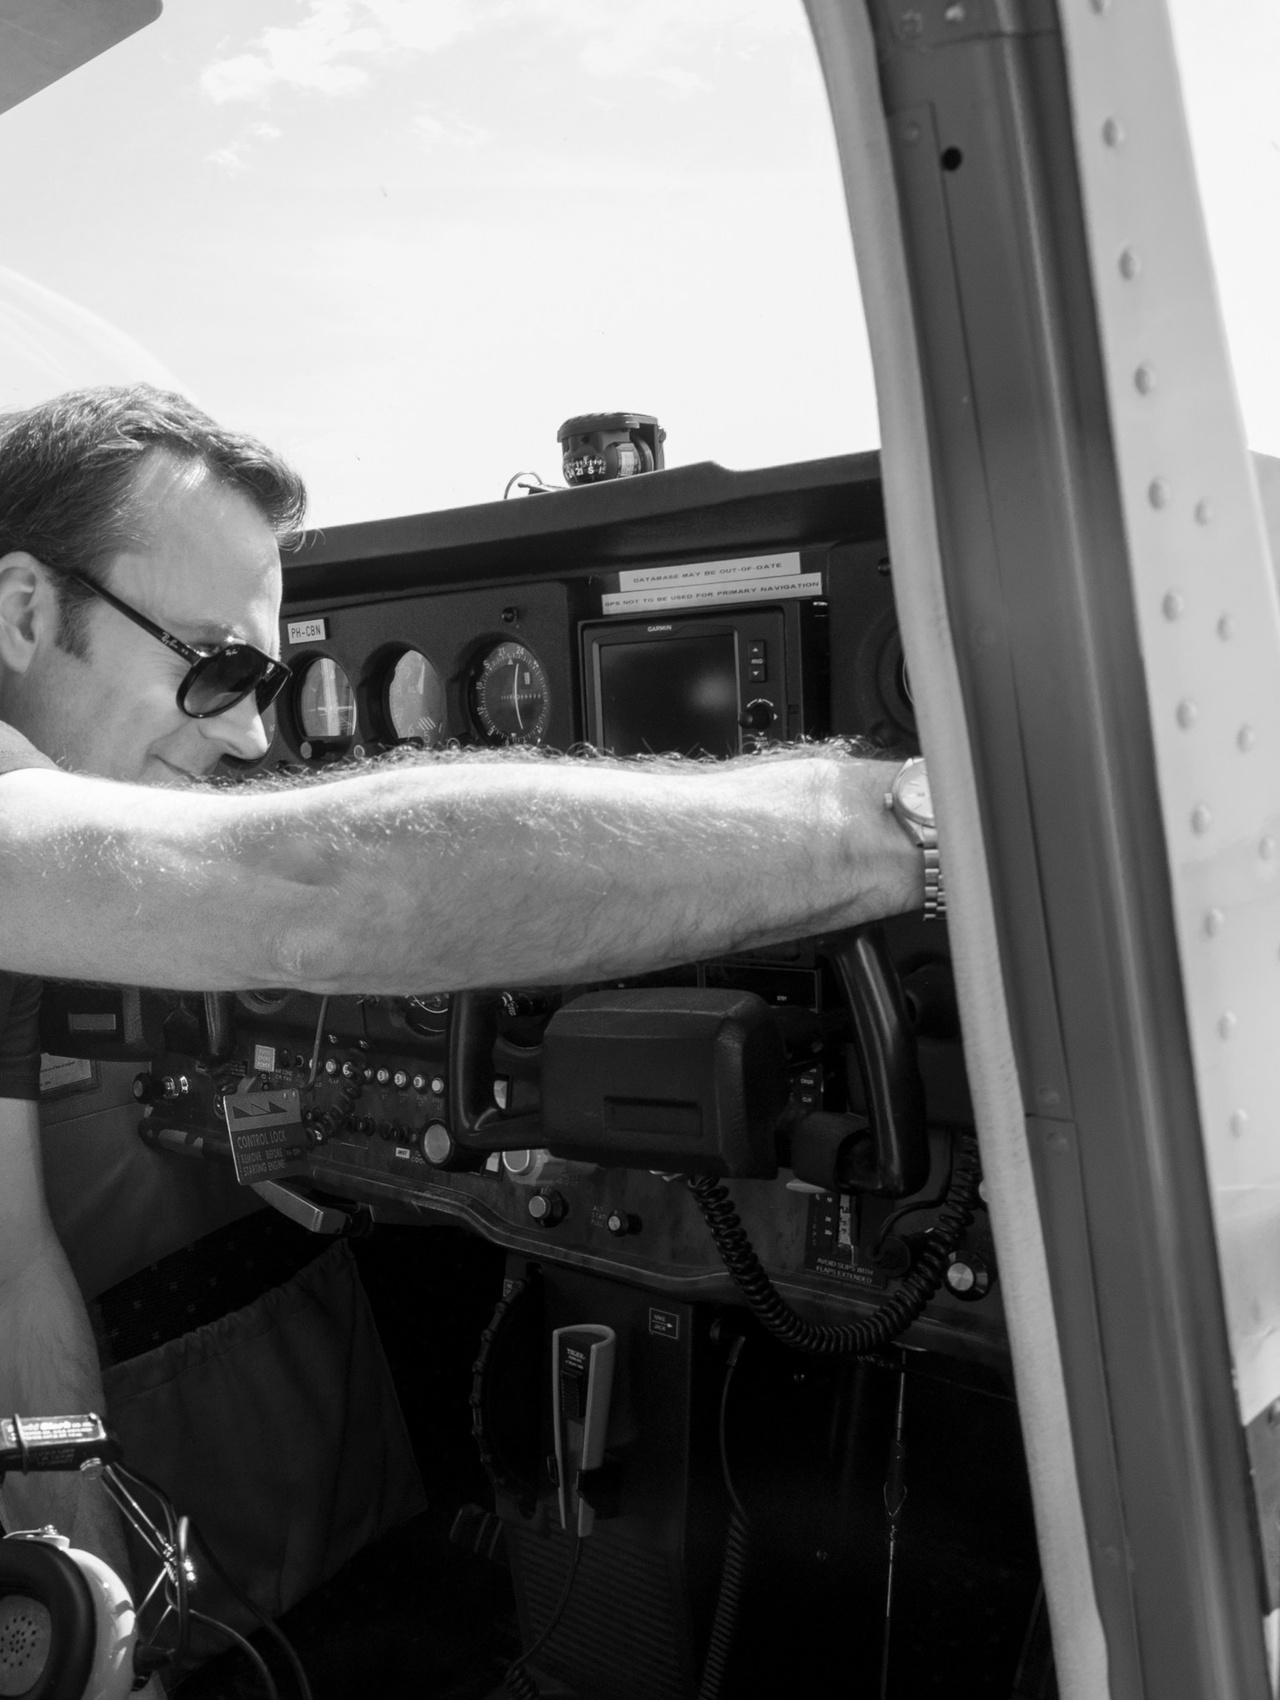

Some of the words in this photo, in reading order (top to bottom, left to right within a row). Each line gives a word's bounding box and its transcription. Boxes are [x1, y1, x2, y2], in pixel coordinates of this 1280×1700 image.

[633, 574, 679, 583] DATABASE
[719, 562, 782, 574] OUT-OF-DATE
[717, 588, 757, 596] PRIMARY
[760, 581, 819, 592] NAVIGATION
[291, 624, 321, 639] PH-CBN
[647, 624, 672, 632] GARMIN
[237, 1133, 269, 1149] CONTROL
[269, 1129, 287, 1143] LOCK
[240, 1151, 263, 1164] REMOVE
[265, 1147, 283, 1160] BEFORE
[242, 1161, 267, 1177] STARTING
[267, 1159, 286, 1172] ENGINE
[815, 1265, 836, 1276] FLAPS
[837, 1270, 873, 1283] EXTENDED
[816, 1257, 837, 1267] AVOID
[837, 1262, 856, 1272] SLIPS
[856, 1267, 874, 1276] WITH
